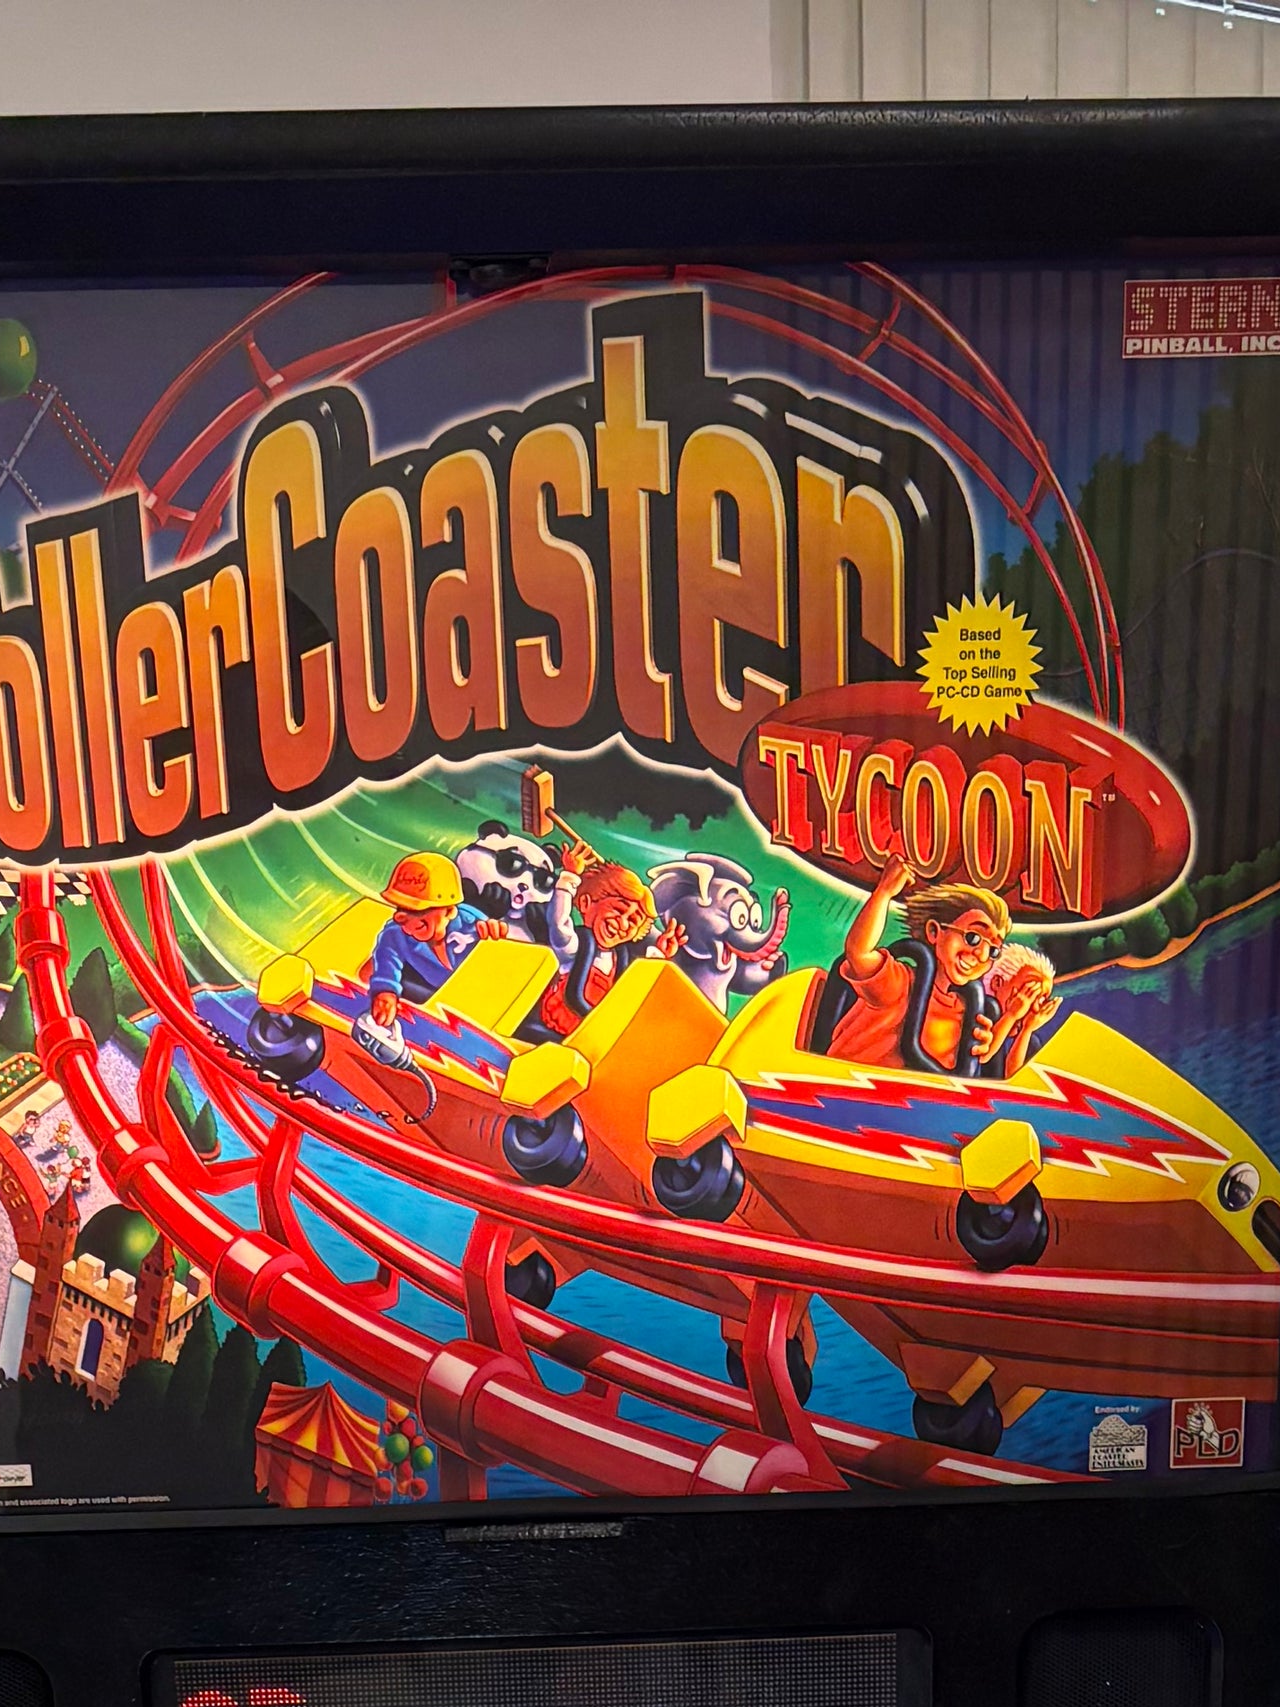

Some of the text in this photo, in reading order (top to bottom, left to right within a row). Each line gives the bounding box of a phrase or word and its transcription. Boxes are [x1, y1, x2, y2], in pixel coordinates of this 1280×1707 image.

[1125, 334, 1234, 355] PINBALL,
[959, 626, 1001, 642] Based
[959, 646, 1001, 661] on the
[942, 664, 1017, 683] Top Selling
[936, 683, 1023, 700] PC-CD Game
[758, 735, 1092, 914] TYCOON
